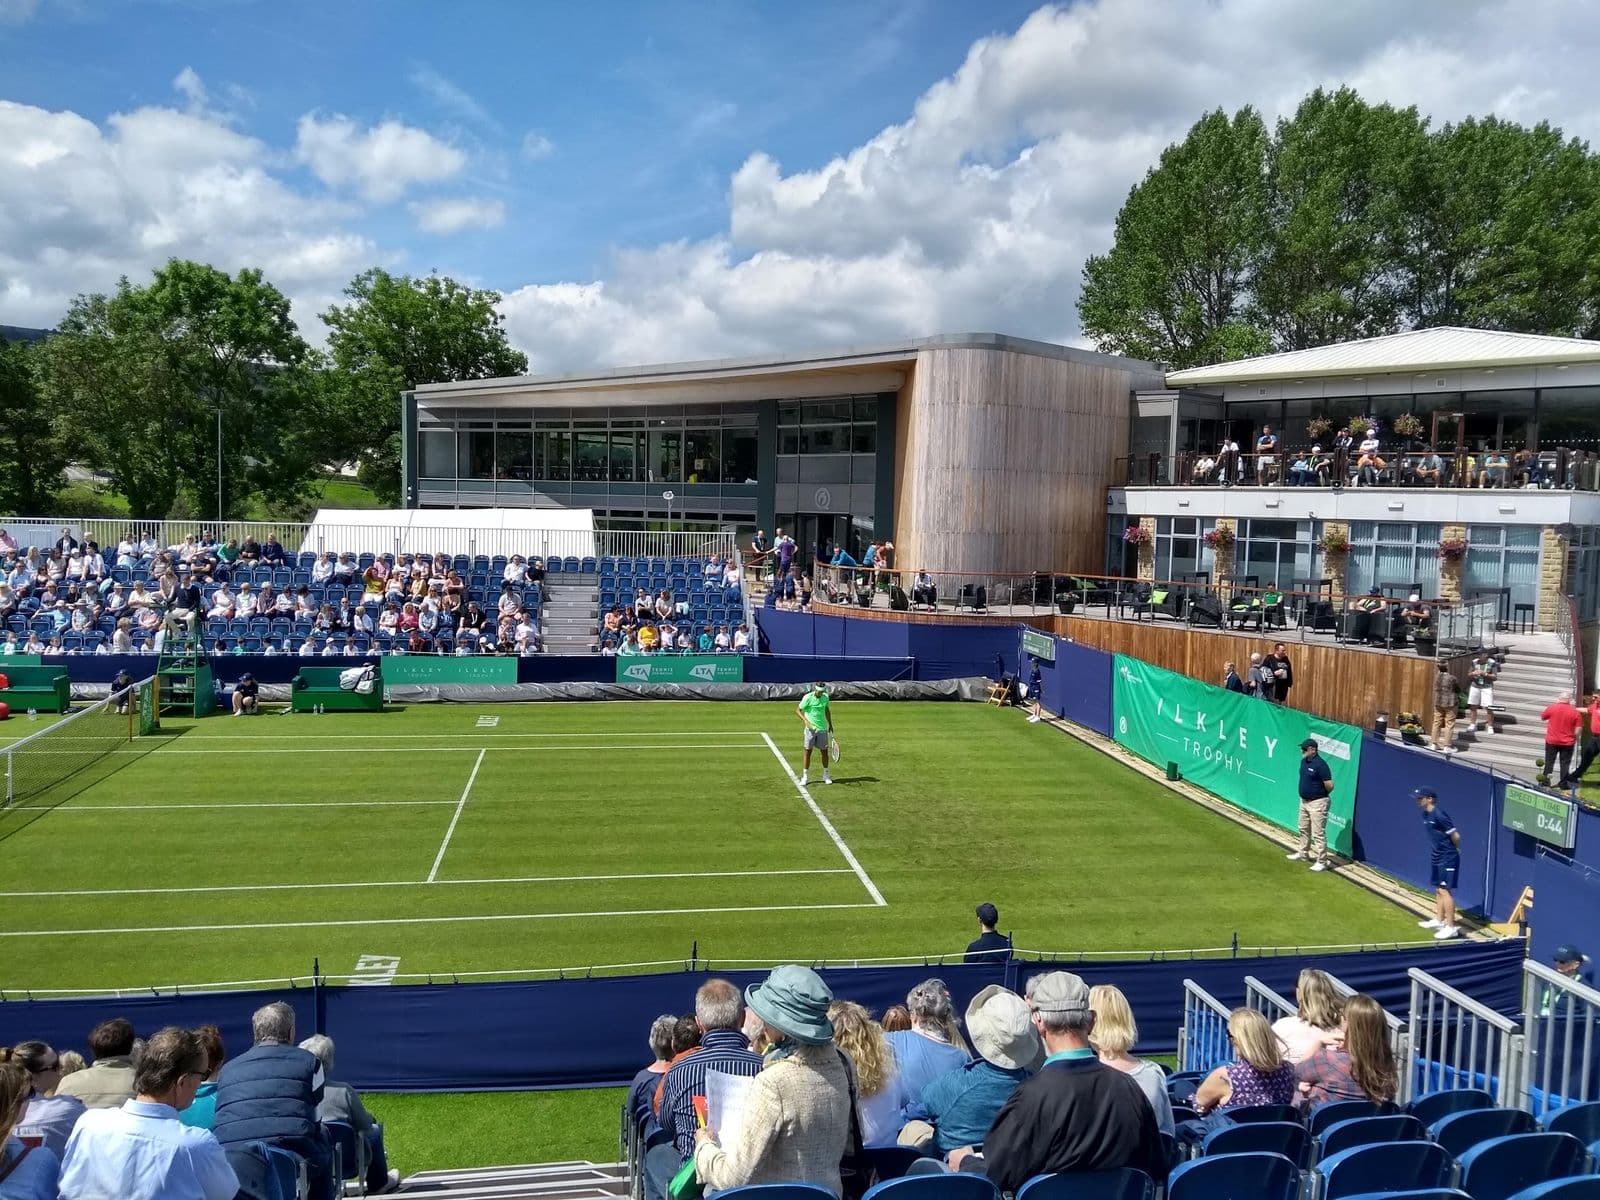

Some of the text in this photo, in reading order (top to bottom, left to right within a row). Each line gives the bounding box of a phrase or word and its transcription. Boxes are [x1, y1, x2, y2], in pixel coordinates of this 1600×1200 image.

[630, 668, 649, 677] LTA
[695, 668, 714, 677] LTA
[1157, 697, 1278, 759] ILKLEY
[1183, 737, 1244, 774] TROPHY
[1508, 788, 1533, 804] SPEED
[1543, 799, 1561, 814] TIME
[1512, 820, 1525, 830] mph
[1537, 813, 1563, 835] 0:44
